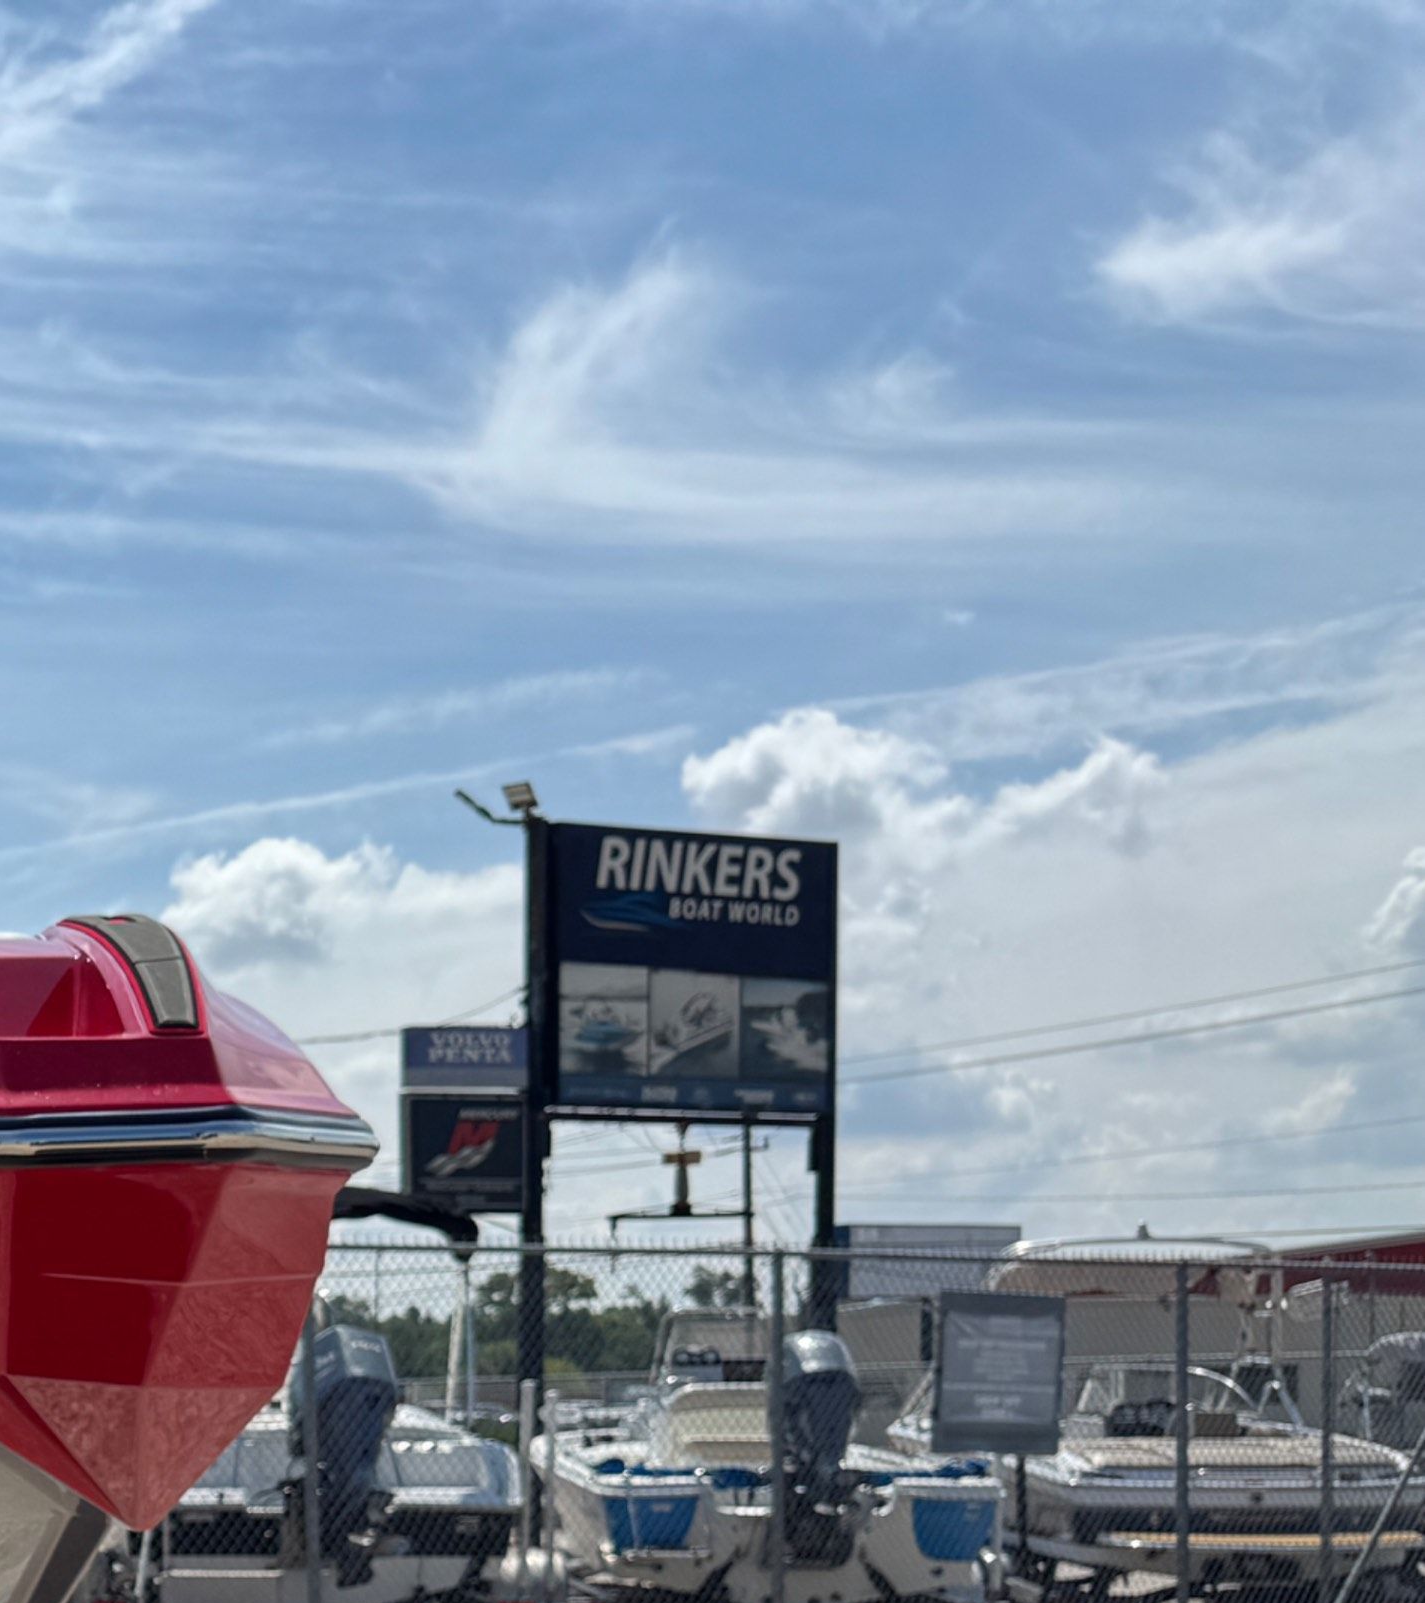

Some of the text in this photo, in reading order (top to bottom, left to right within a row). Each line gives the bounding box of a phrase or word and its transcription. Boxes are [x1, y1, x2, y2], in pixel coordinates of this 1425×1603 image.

[596, 835, 802, 900] RINKERS
[668, 897, 800, 927] BOAT WORLD
[430, 1031, 511, 1047] VOLVO
[427, 1047, 513, 1064] PENTA
